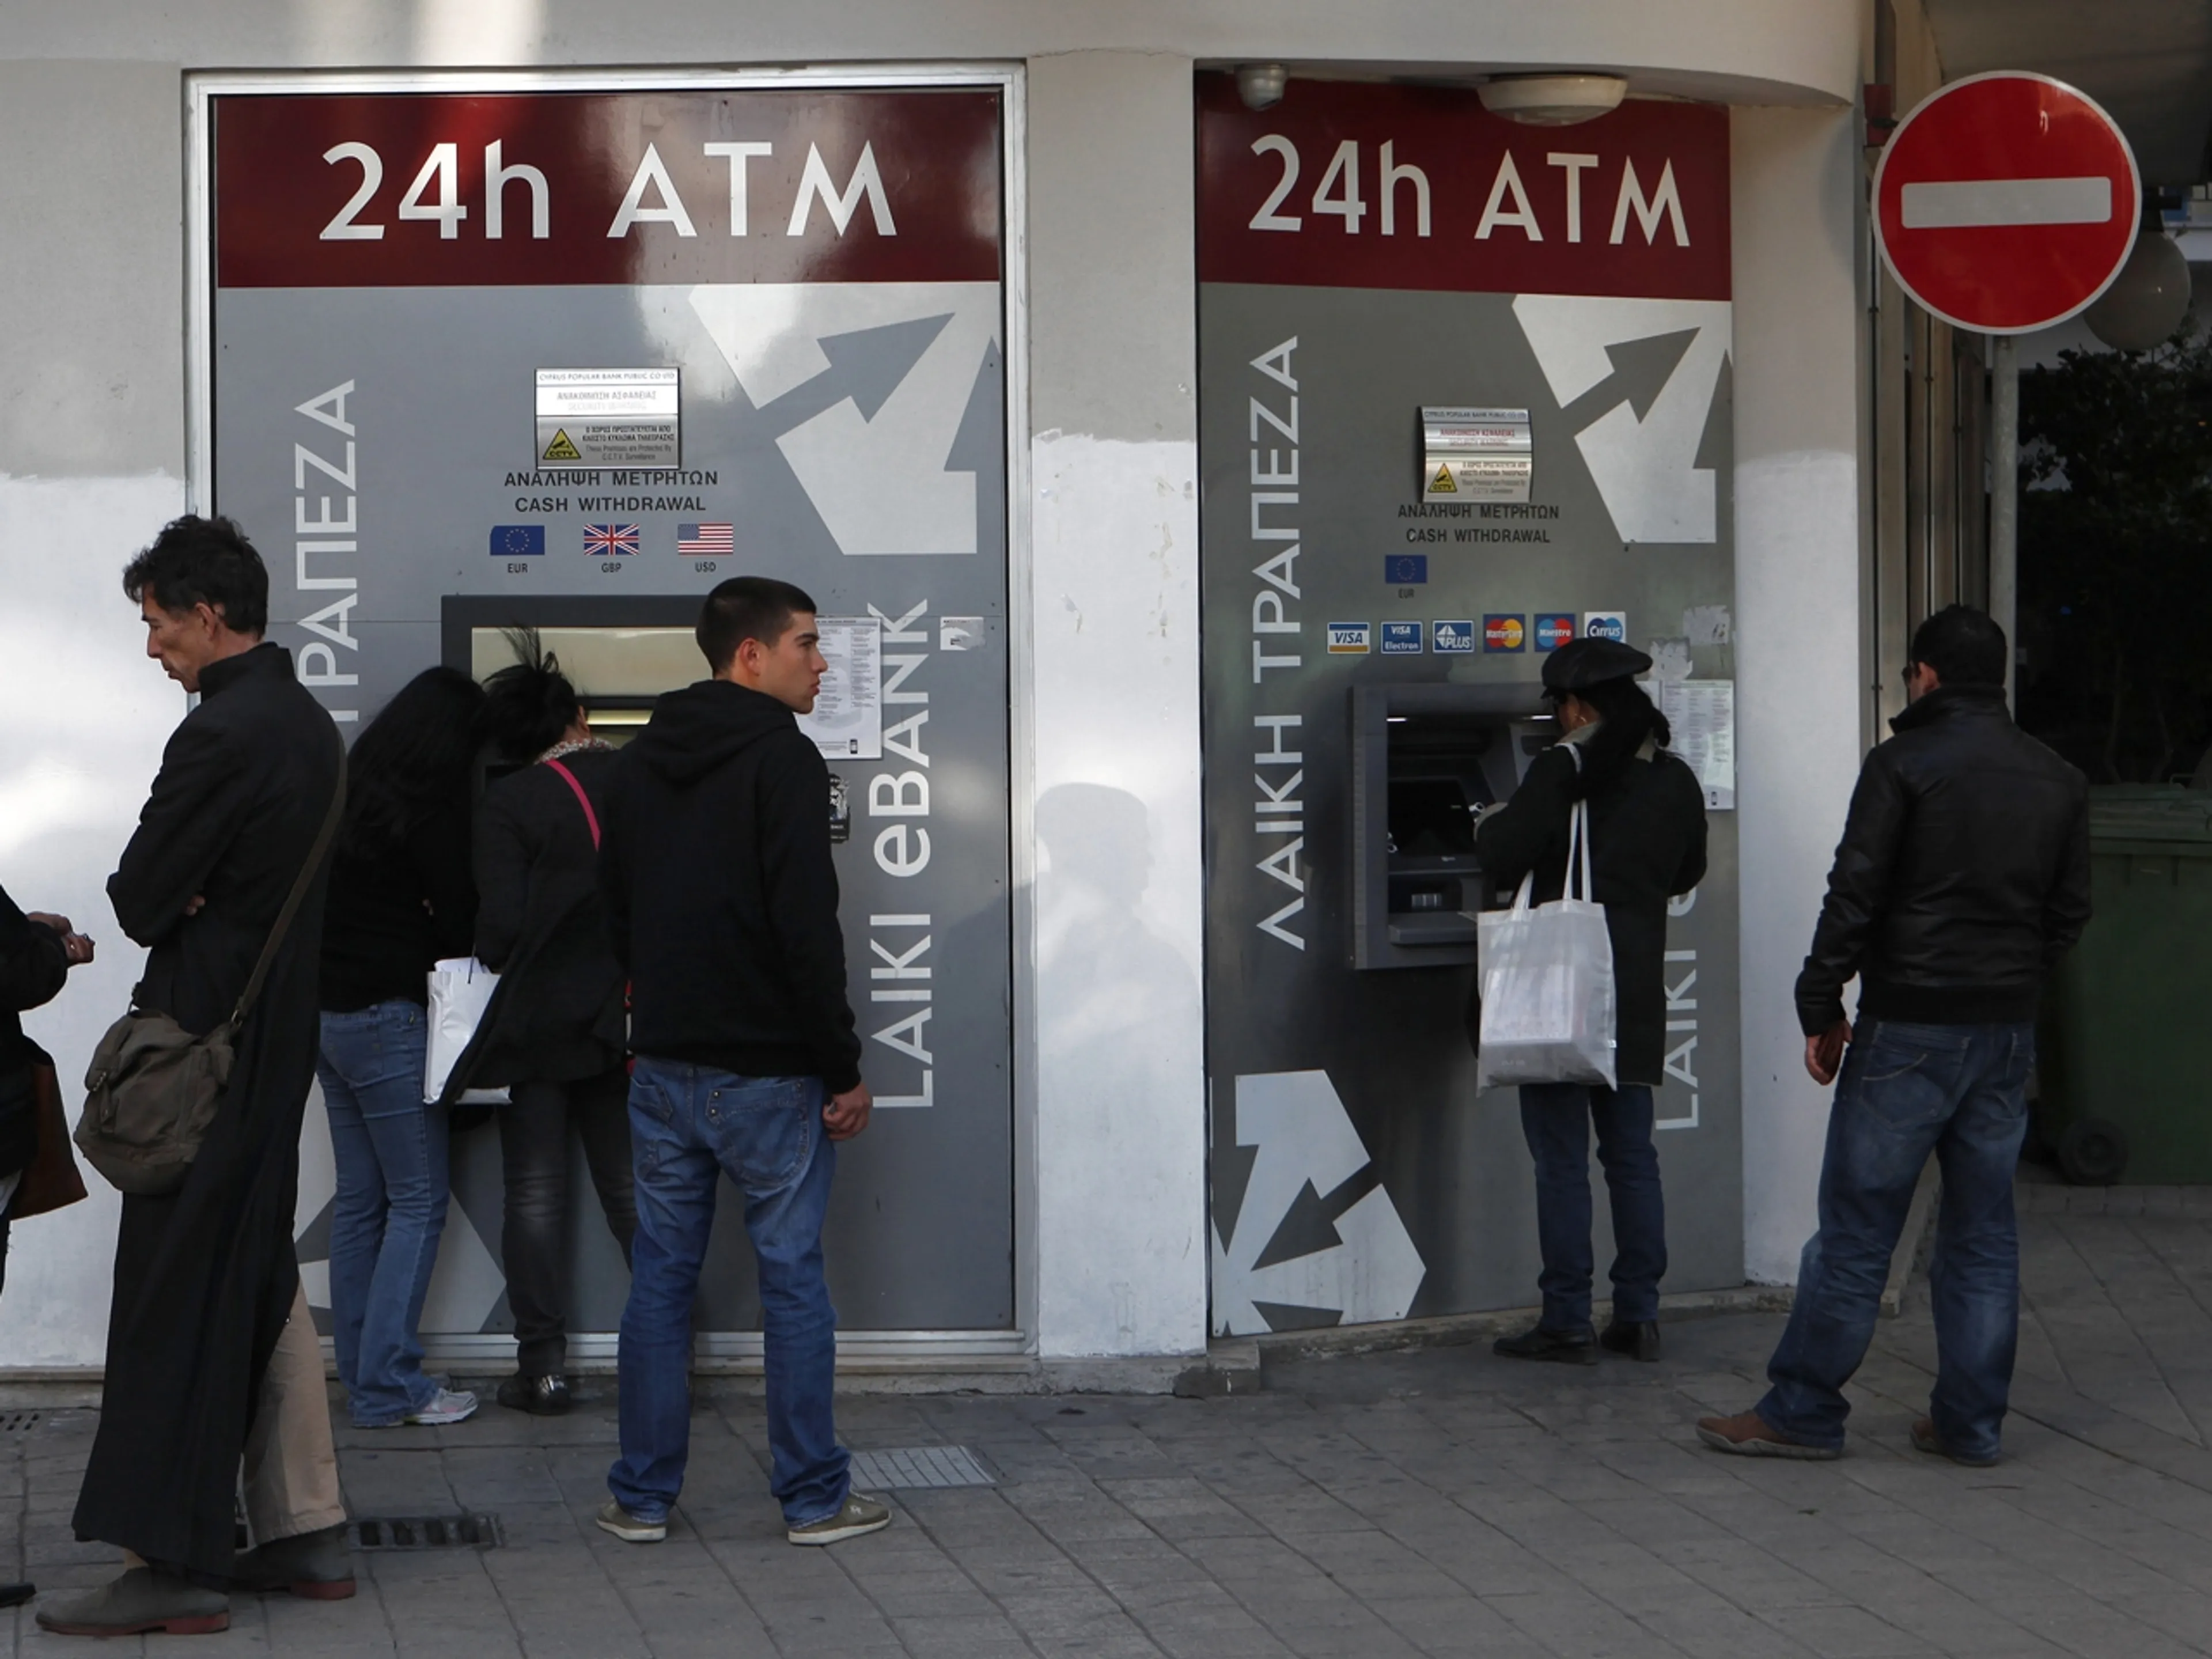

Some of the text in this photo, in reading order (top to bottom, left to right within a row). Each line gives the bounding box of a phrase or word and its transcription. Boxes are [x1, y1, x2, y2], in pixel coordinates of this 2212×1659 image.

[319, 139, 897, 240] 24h ATM
[1249, 134, 1691, 247] 24h ATM
[504, 471, 718, 487] ΑΝΑΛΗΨΗ ΜΕΤΡΗΤΩΝ
[514, 497, 706, 512] CASH WITHDRAWAL
[1397, 505, 1559, 519] ΑΝΑΛΗΨΗ ΜΕΤΡΗΤΩΝ
[1406, 528, 1550, 543] CASH WITHDRAWAL
[507, 563, 528, 573] EUR
[601, 563, 622, 573] GBP
[695, 562, 717, 573] USD
[1391, 626, 1411, 635] VISA
[1486, 629, 1523, 639] MasterCard
[1539, 628, 1572, 637] Maestro
[1589, 625, 1620, 637] Cirrus
[1249, 335, 1305, 952] ΛΑΙΚΗ ΤΡΑΠΕΖΑ
[1334, 632, 1363, 644] VISA
[1445, 635, 1471, 649] PLUS
[1384, 641, 1419, 650] Electron
[867, 599, 934, 1108] LAIKI eBANK
[1656, 949, 1699, 1130] LAIKI
